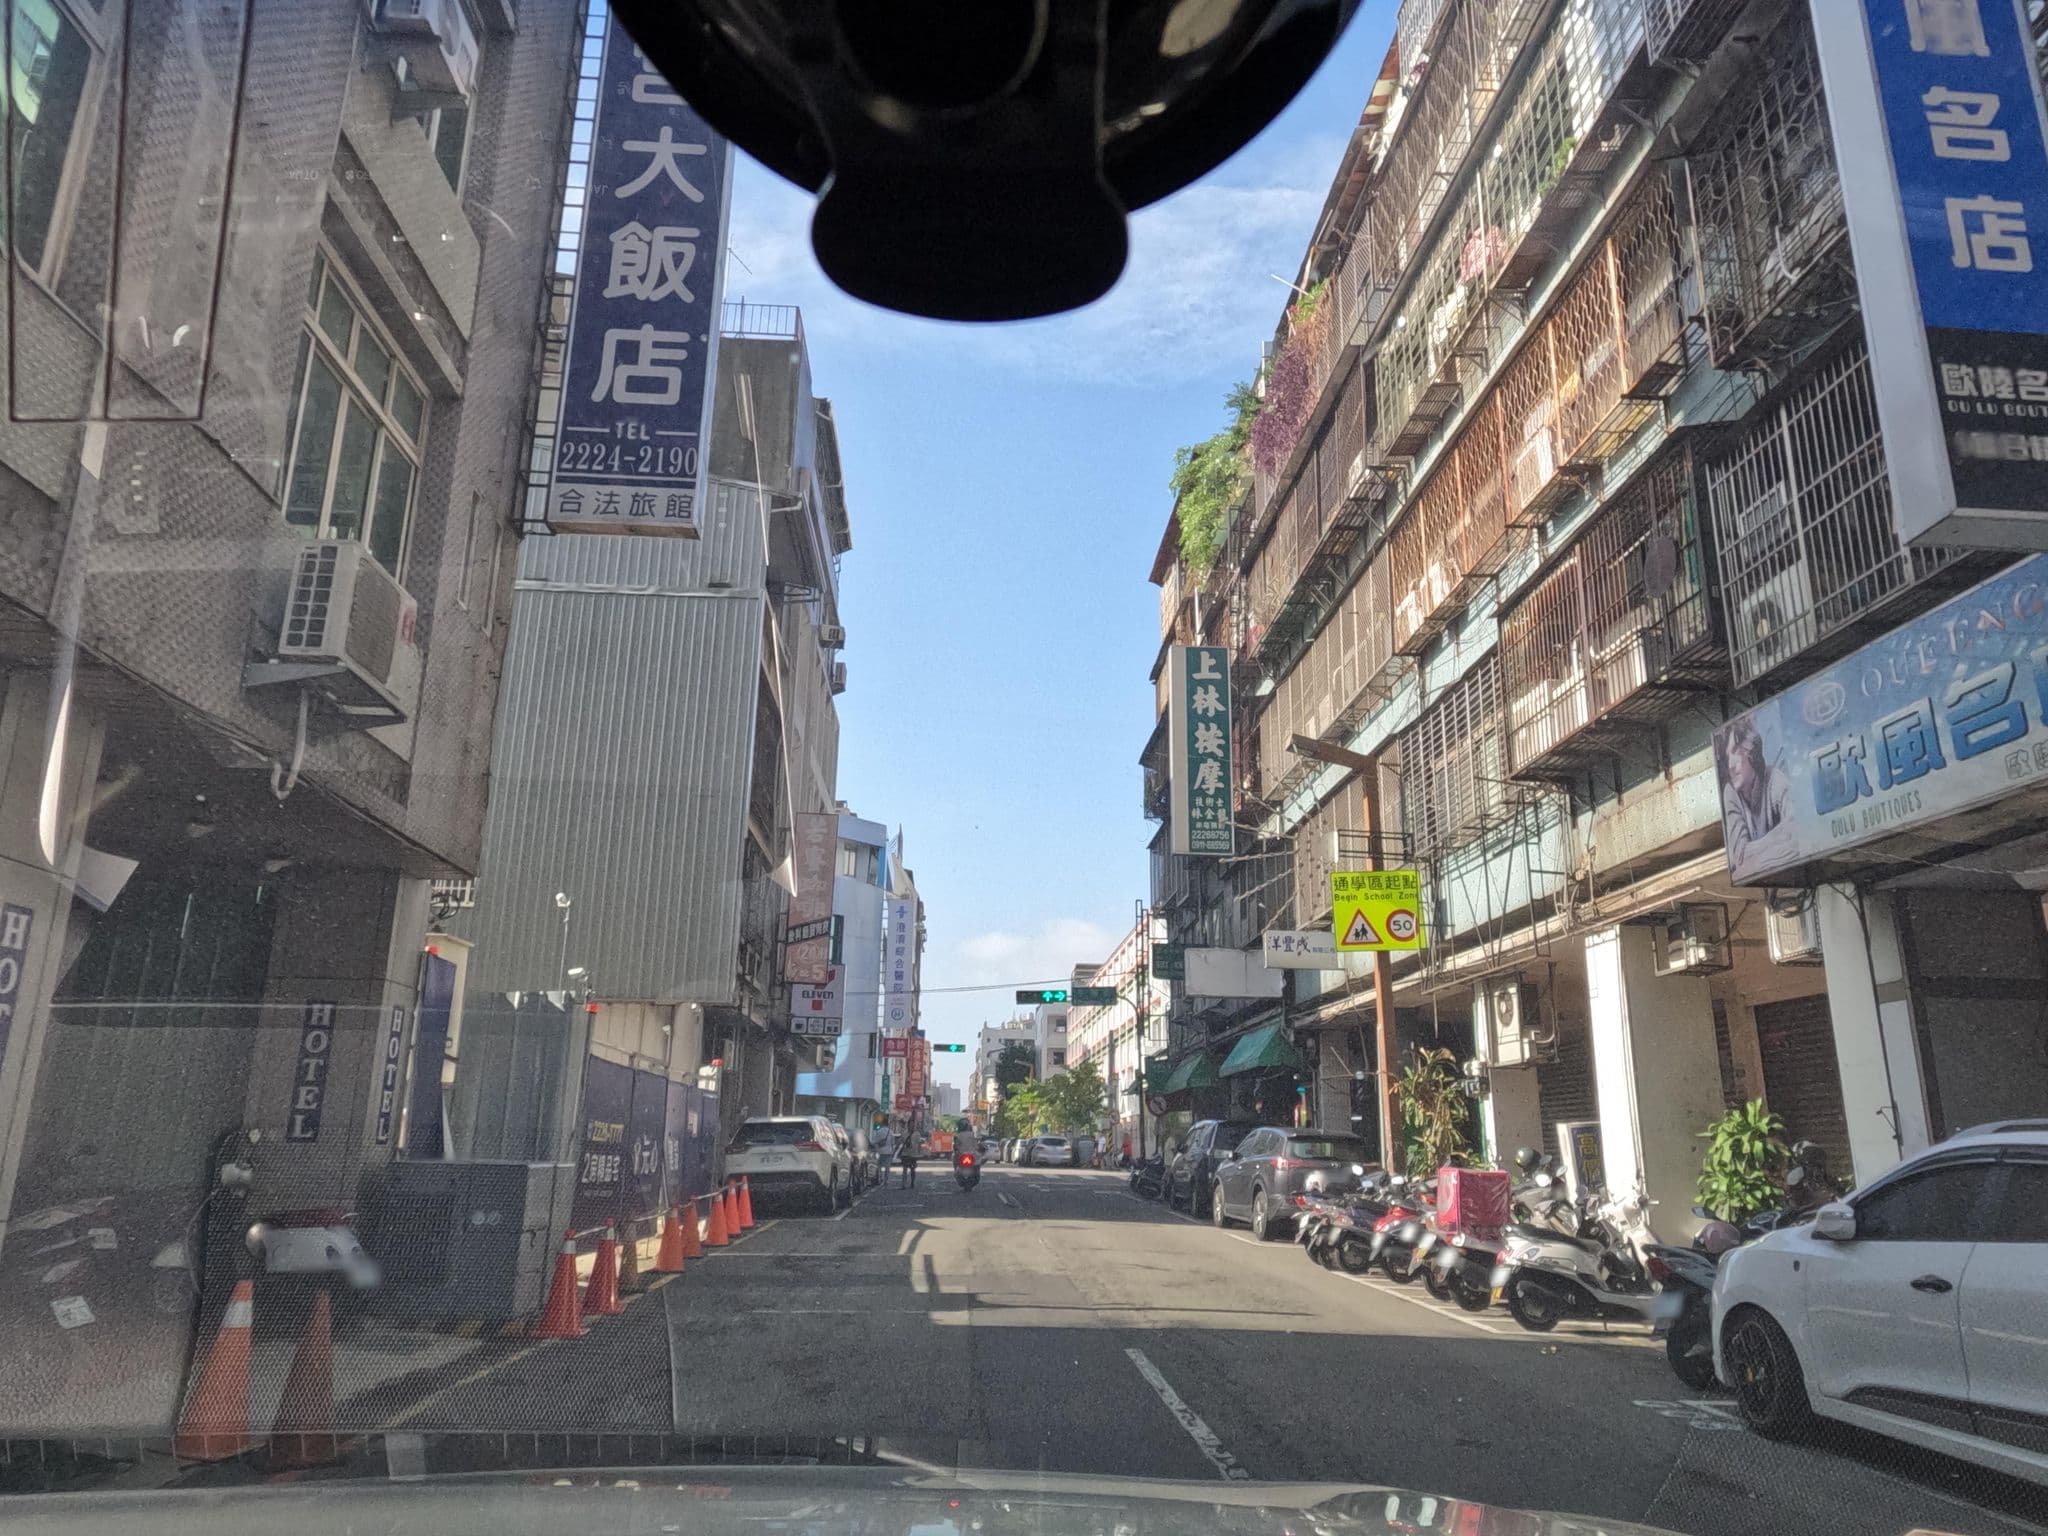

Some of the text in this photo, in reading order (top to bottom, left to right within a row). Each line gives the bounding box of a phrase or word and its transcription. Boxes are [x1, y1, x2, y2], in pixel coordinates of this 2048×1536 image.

[616, 421, 651, 441] TEL
[560, 441, 698, 476] 2224-2190
[558, 488, 694, 520] 合法旅館
[1191, 650, 1226, 796] 上林按摩
[1808, 645, 2048, 816] 歐風名
[1334, 874, 1418, 892] 通學區起點
[1334, 892, 1359, 903] Begin
[1363, 891, 1394, 901] School
[1392, 919, 1413, 932] 50
[293, 1003, 335, 1139] HOTEL
[378, 1009, 403, 1141] HOTEL
